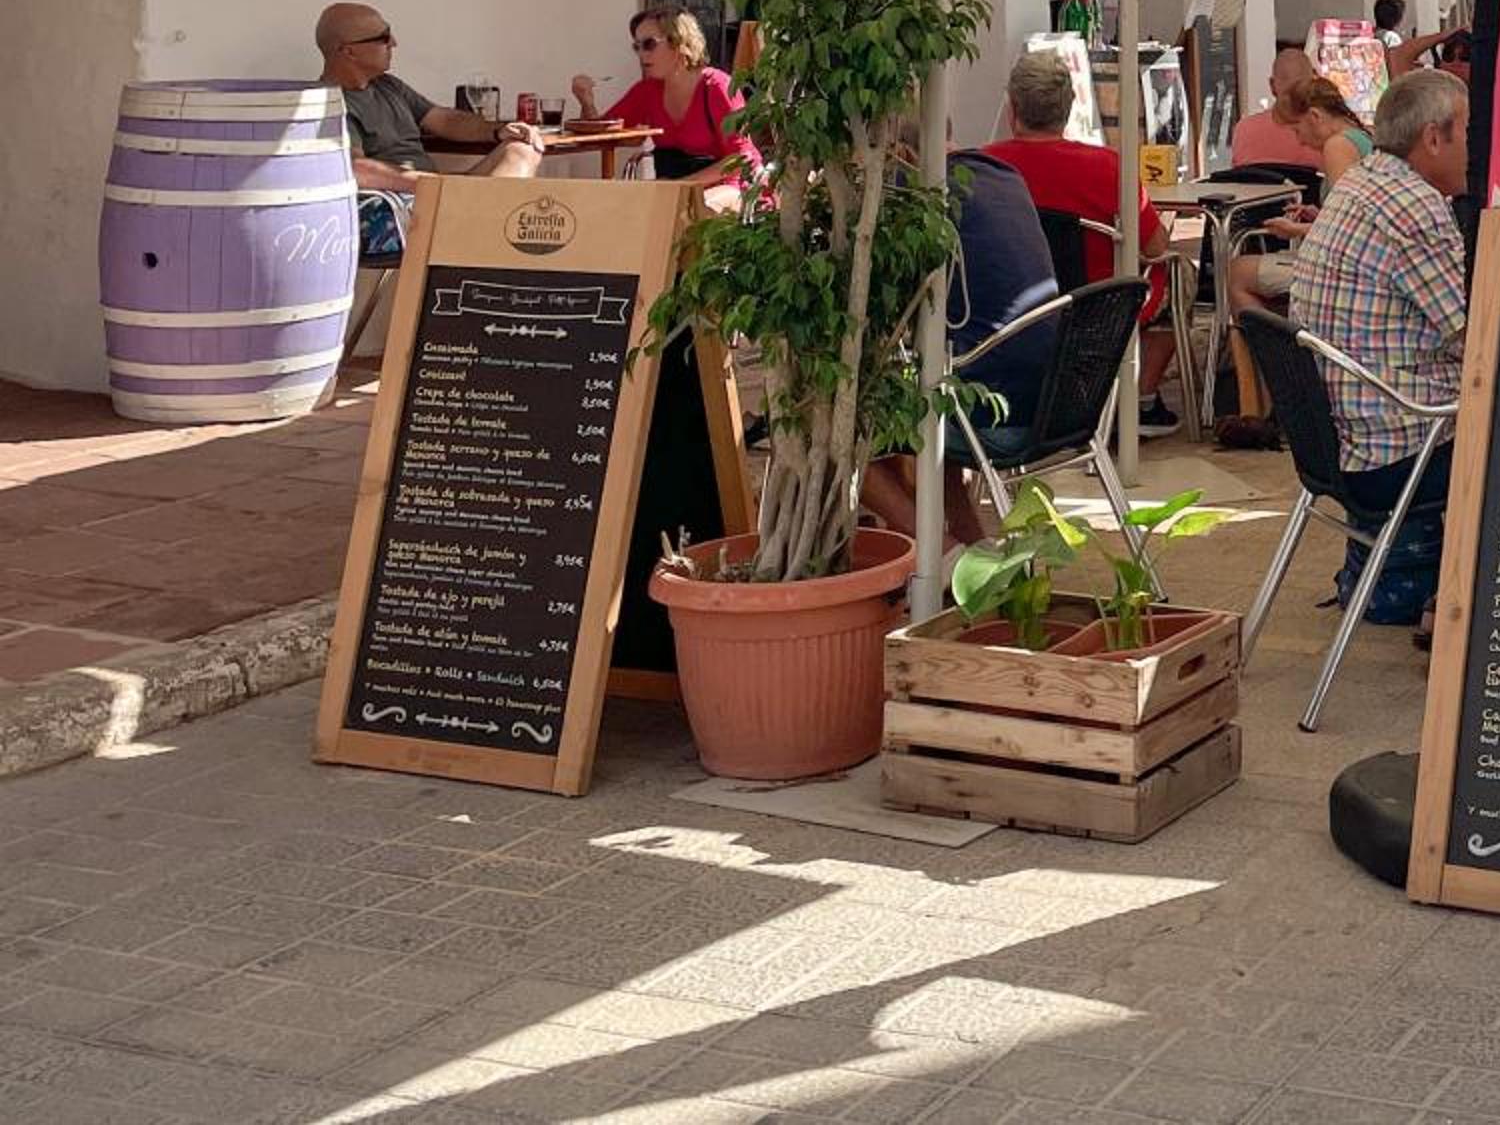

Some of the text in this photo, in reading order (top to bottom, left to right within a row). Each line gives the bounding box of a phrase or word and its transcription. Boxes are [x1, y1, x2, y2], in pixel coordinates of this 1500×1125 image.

[517, 212, 566, 227] Estrella
[517, 226, 562, 242] Galicia
[447, 387, 461, 399] de
